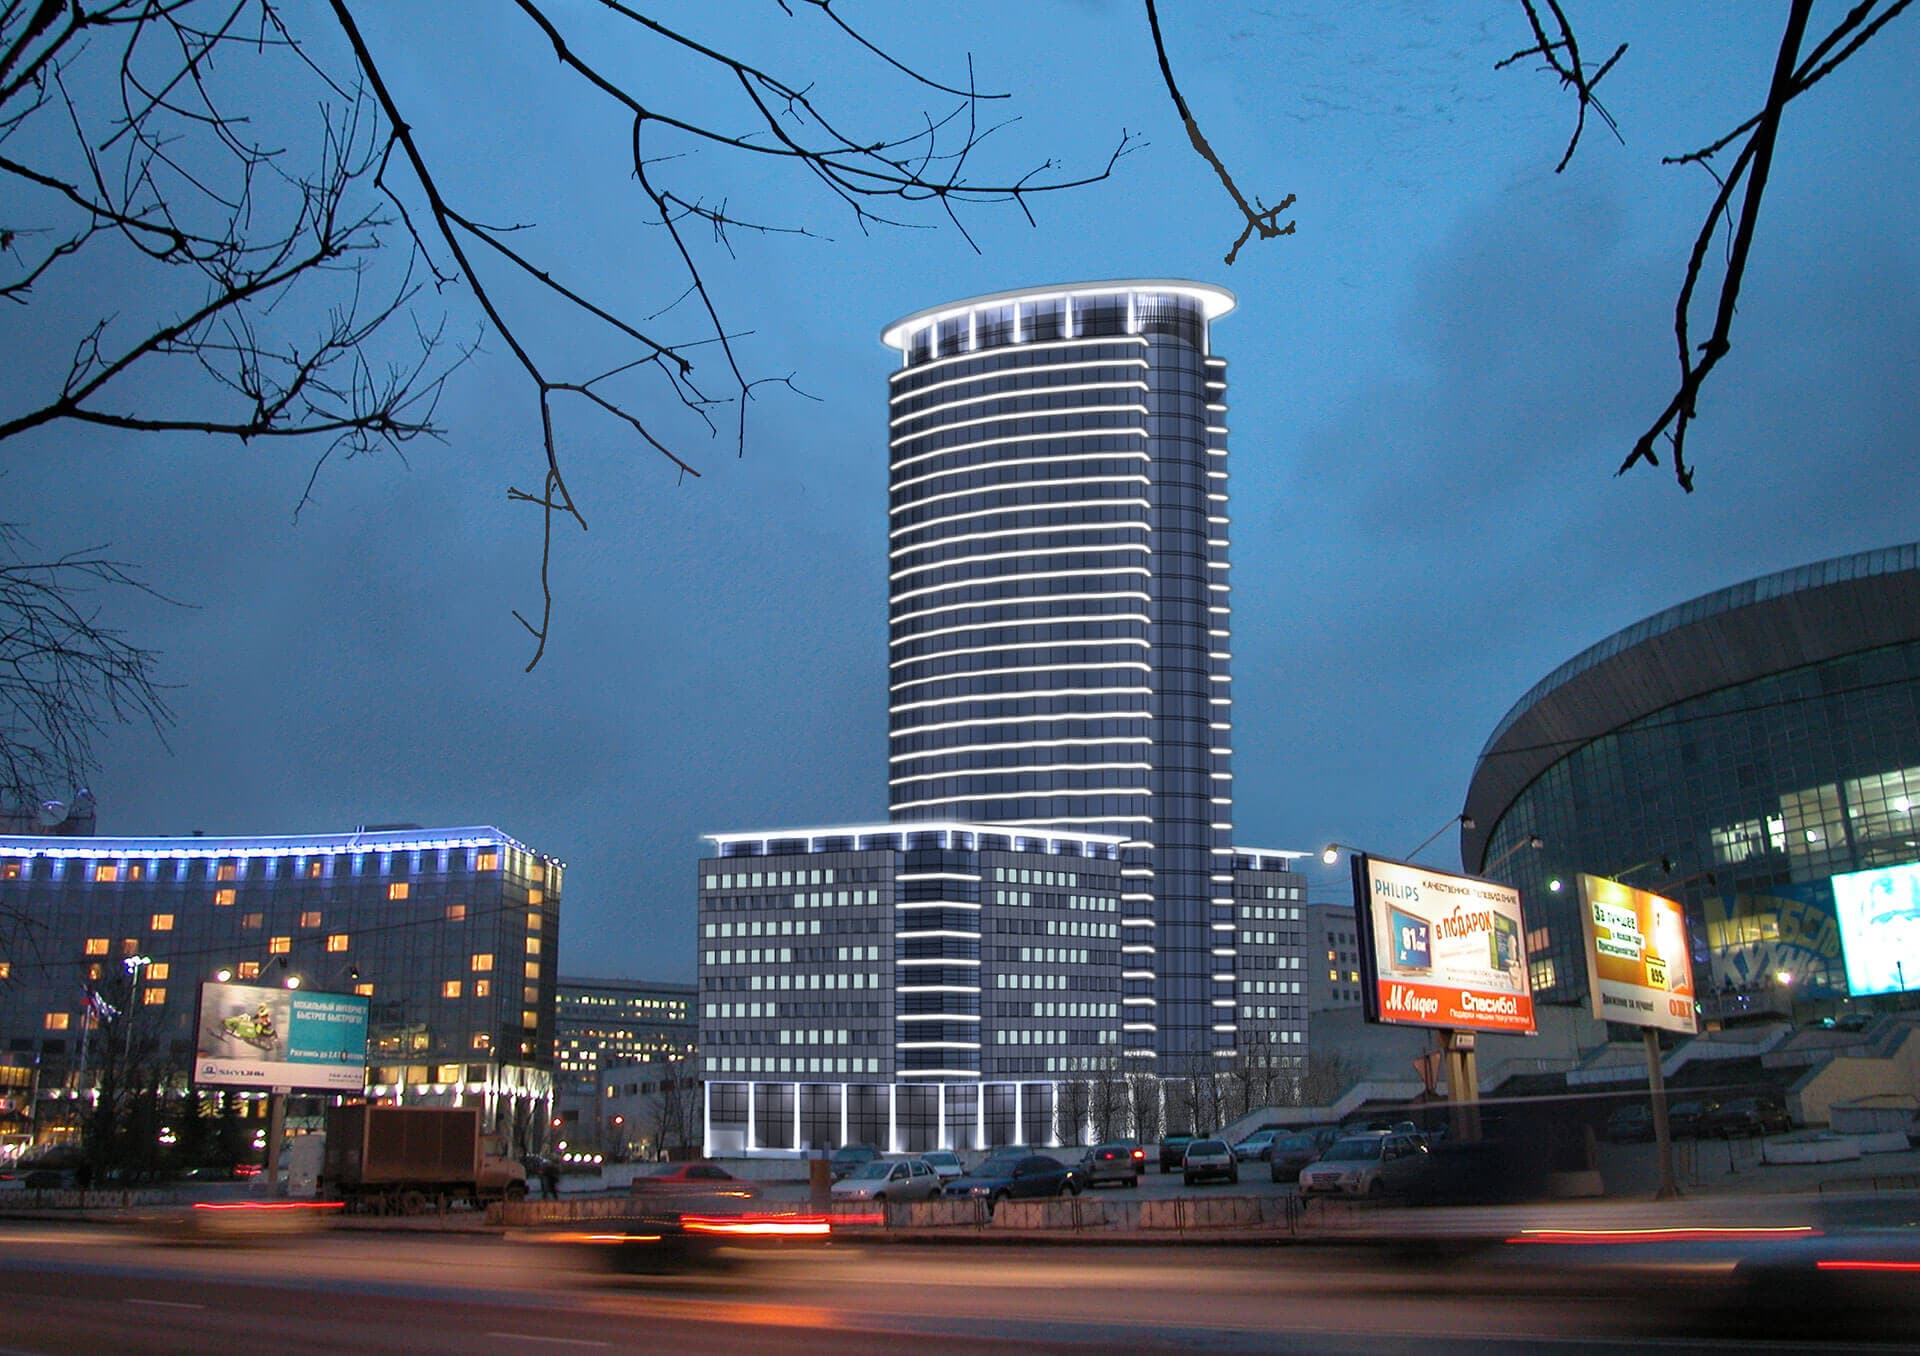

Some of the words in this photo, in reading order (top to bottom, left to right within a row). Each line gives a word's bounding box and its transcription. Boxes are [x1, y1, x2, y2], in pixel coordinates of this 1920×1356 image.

[1375, 879, 1419, 901] PHILIPS
[1422, 881, 1470, 896] КАЧЕСТВЕННОЕ
[1443, 905, 1493, 939] ПОДАРОК
[1402, 926, 1417, 951] 81
[1461, 991, 1518, 1015] Спасибо!
